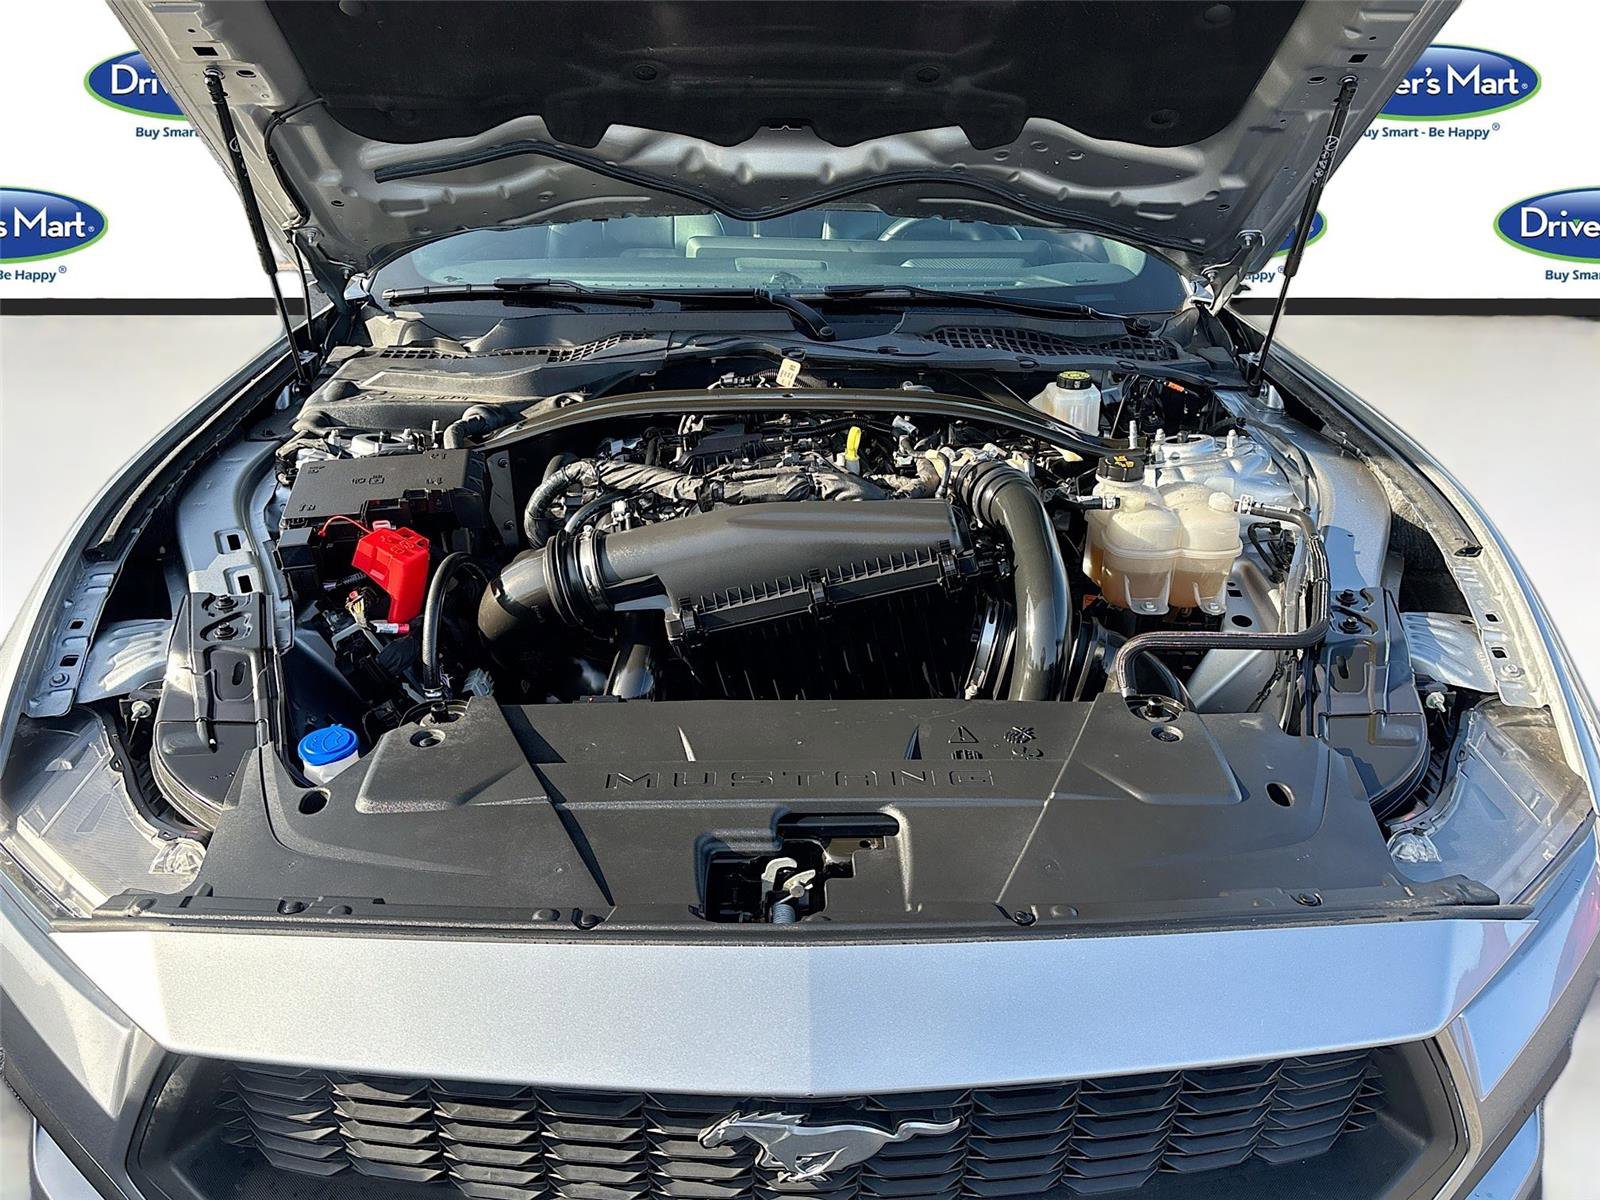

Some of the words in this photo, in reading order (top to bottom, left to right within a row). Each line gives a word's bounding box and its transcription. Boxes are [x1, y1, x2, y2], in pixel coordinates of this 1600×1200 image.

[1447, 64, 1519, 95] Mart
[135, 127, 160, 140] Buy
[1362, 128, 1380, 140] uy
[1382, 127, 1419, 138] Smart
[1428, 127, 1445, 138] Be
[1448, 127, 1490, 140] Happy
[14, 206, 86, 238] Mart
[15, 270, 57, 283] Happy
[1545, 269, 1569, 283] Buy
[1572, 269, 1600, 280] Sma
[605, 768, 995, 790] MUSTANG
